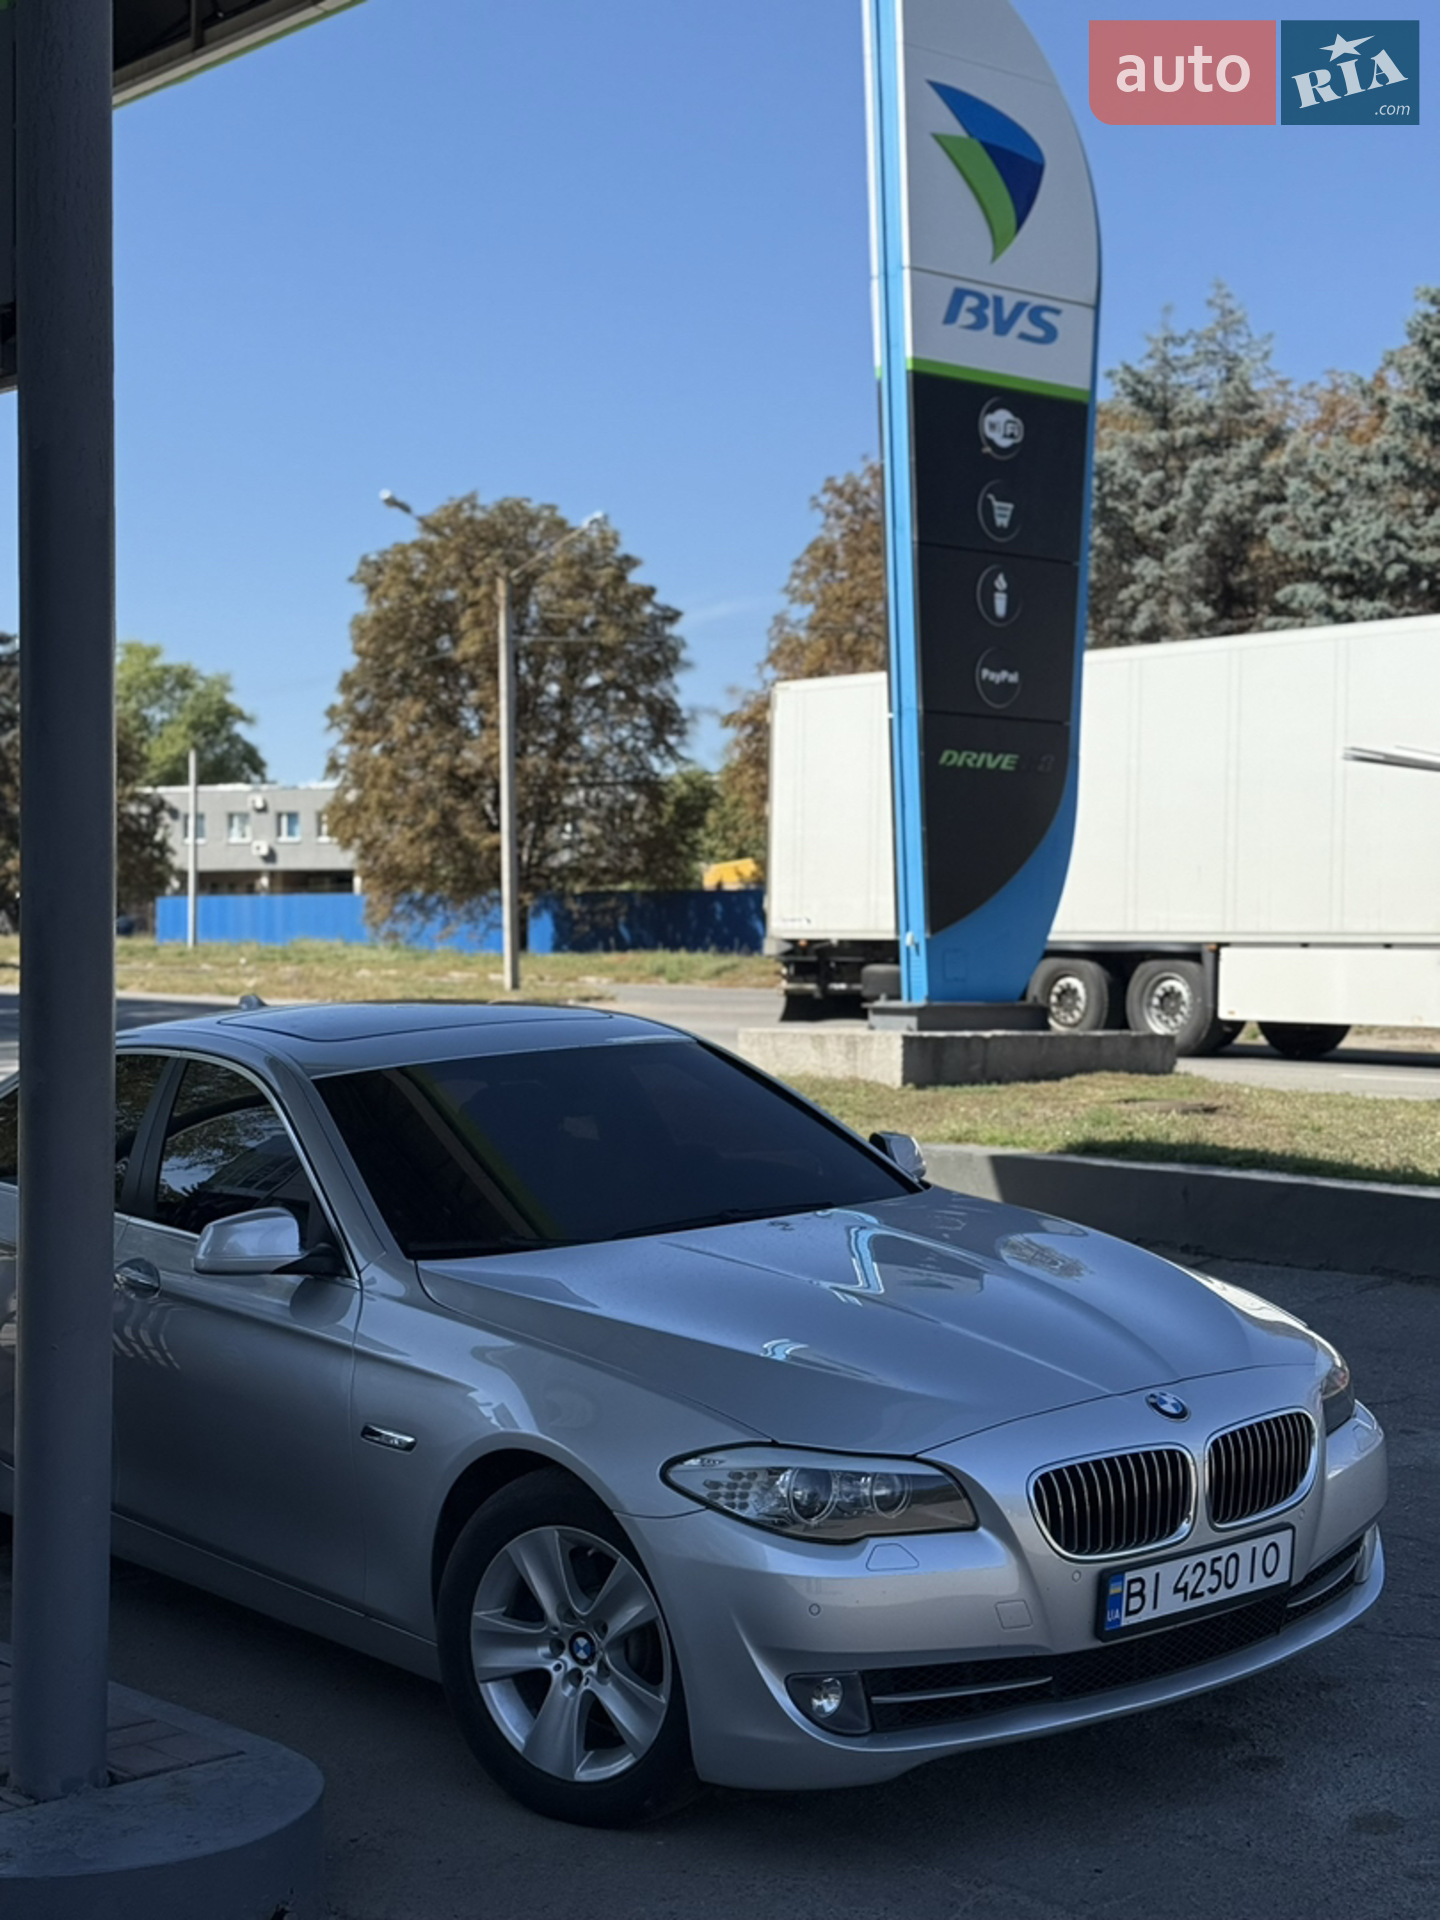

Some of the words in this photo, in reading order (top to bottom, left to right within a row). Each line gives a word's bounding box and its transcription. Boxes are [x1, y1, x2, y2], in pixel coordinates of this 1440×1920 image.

[942, 286, 1062, 346] BVS
[981, 667, 1019, 685] PayPal
[939, 749, 1019, 770] DRIVE
[1125, 1572, 1160, 1617] BI
[1173, 1552, 1240, 1602] 4250
[1249, 1541, 1281, 1584] IO
[1106, 1609, 1121, 1622] UA
